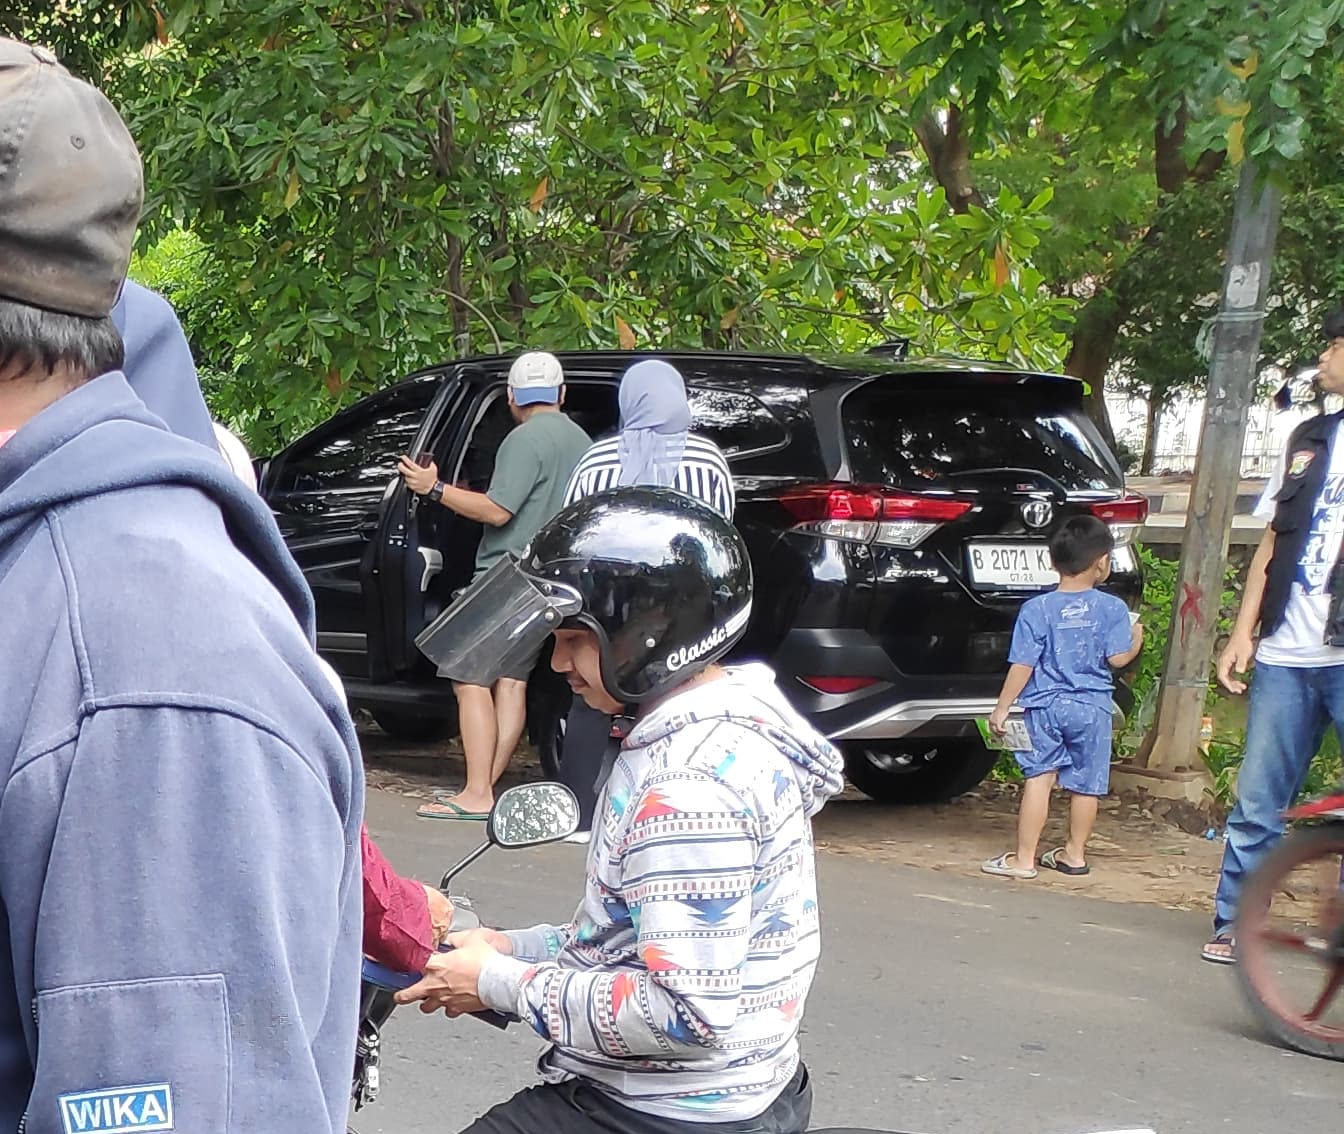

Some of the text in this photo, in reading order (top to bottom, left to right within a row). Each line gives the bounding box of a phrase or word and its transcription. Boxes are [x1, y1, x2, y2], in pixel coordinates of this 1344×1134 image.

[973, 549, 984, 570] B
[991, 549, 1030, 571] 2071
[666, 627, 727, 672] Classic
[68, 1093, 166, 1130] WIKA
